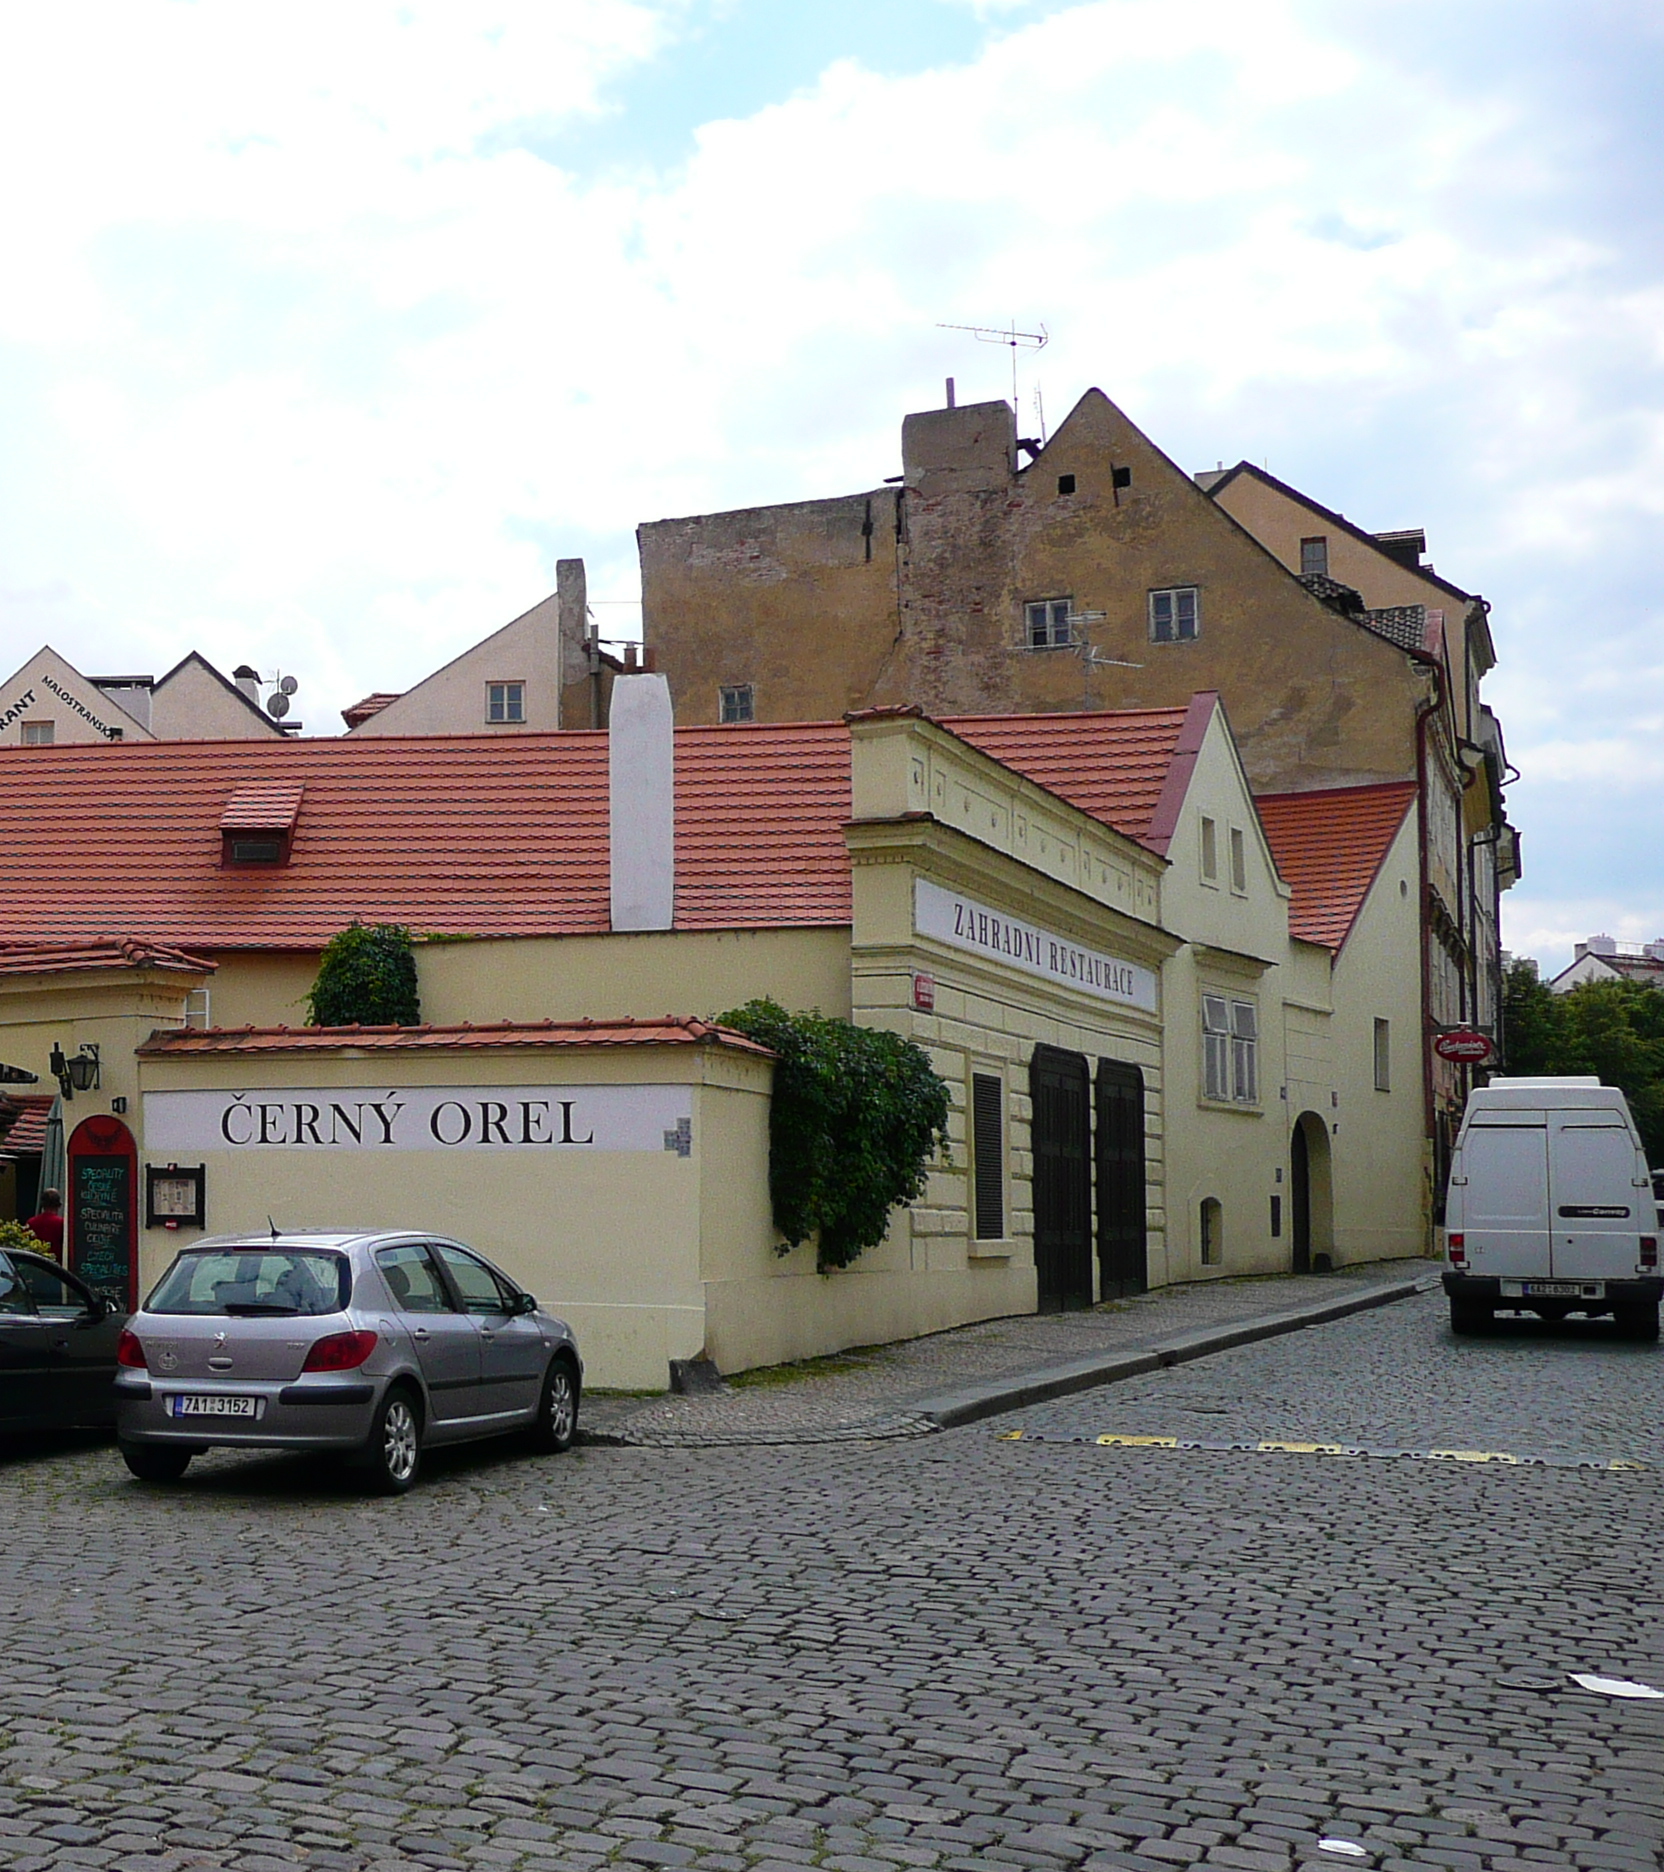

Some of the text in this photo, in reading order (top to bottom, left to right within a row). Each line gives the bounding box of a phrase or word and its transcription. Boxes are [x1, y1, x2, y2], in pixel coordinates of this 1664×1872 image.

[954, 903, 1134, 996] ZAHRADNÍ RESTAURACE
[221, 1091, 594, 1146] ČERNÝ OREL
[184, 1397, 249, 1413] 7A1 3152
